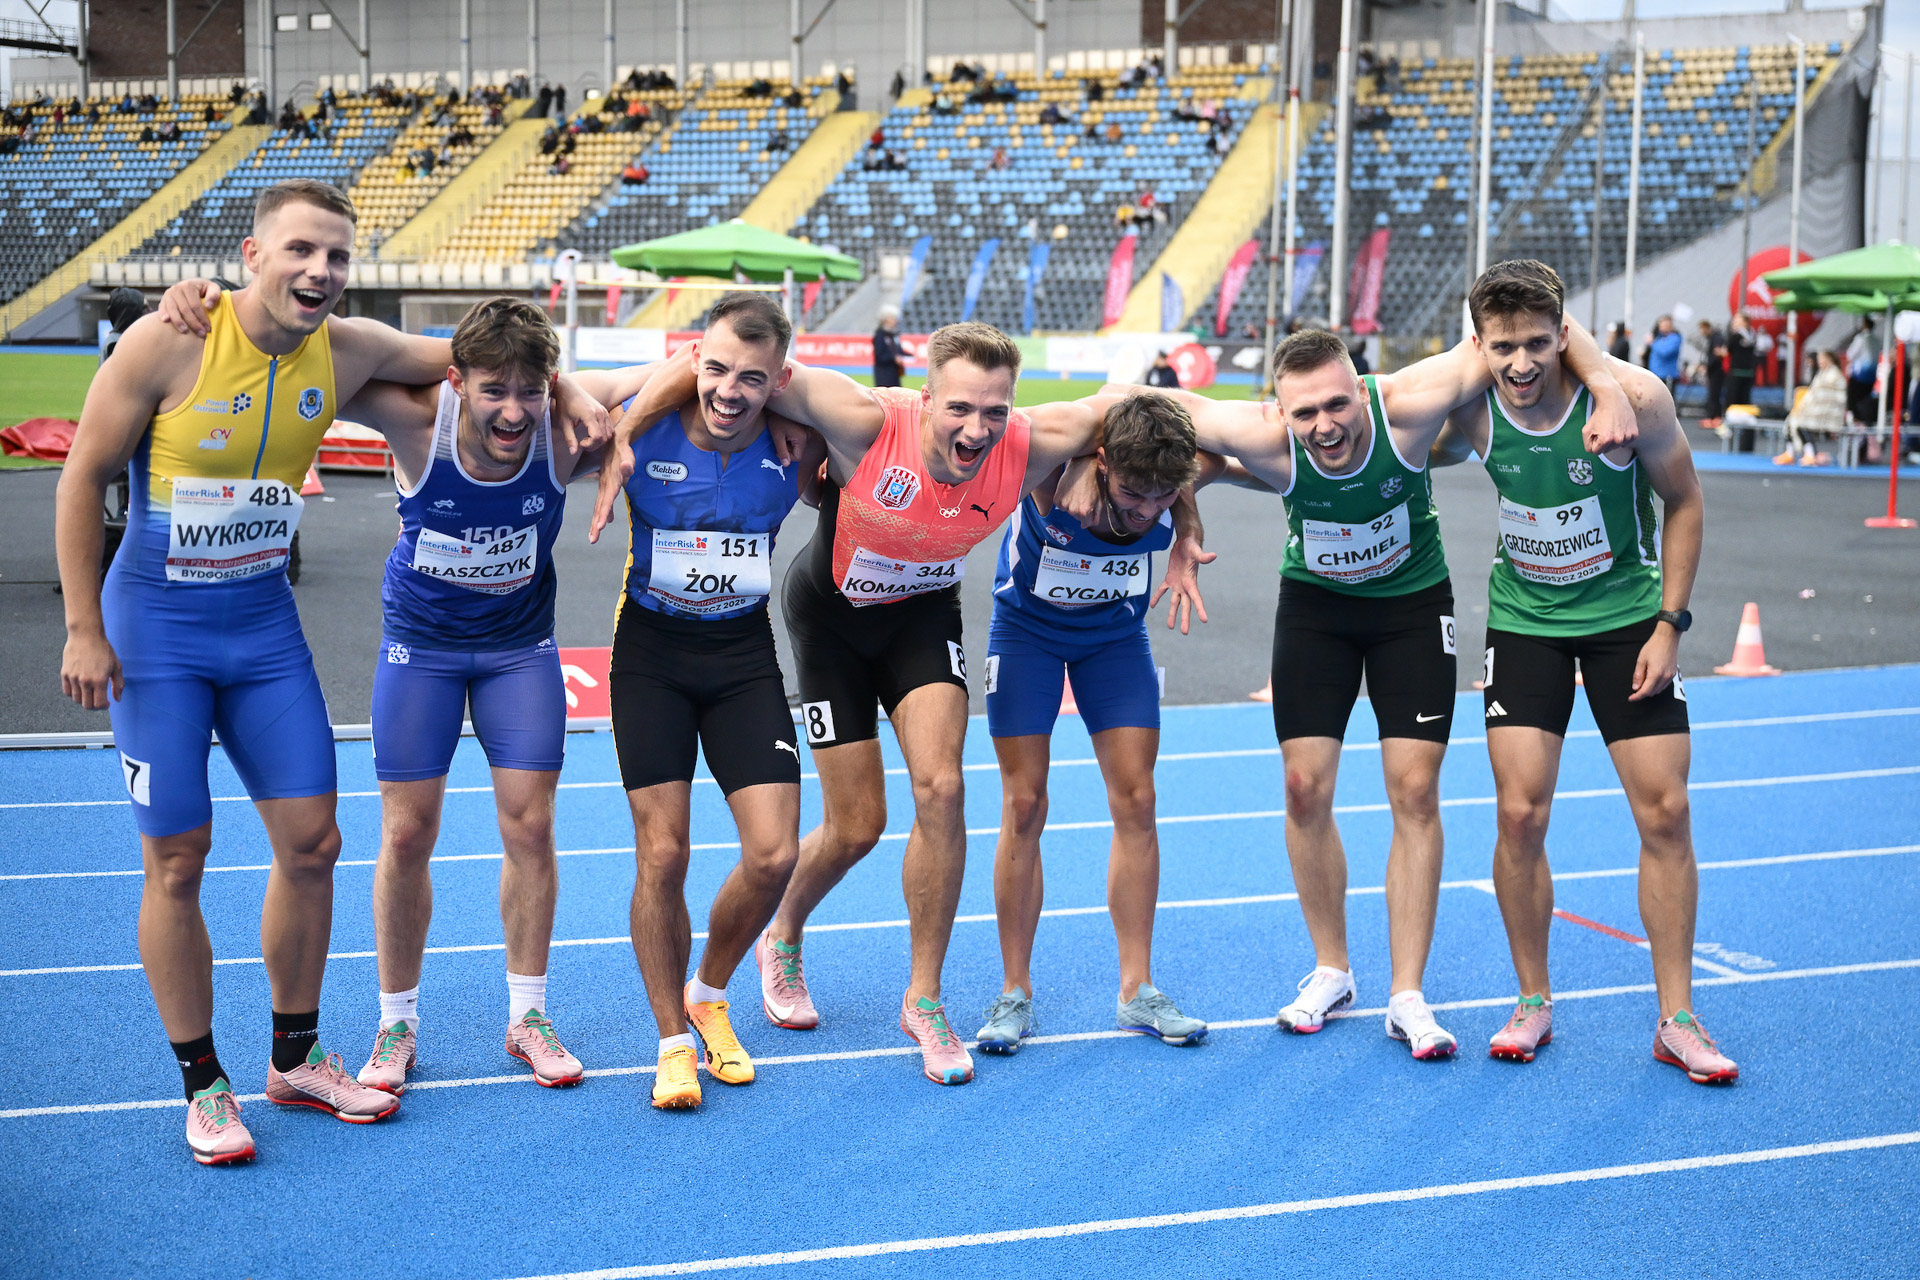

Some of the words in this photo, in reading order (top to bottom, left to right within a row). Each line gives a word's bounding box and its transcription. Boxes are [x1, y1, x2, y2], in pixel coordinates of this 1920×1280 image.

[175, 487, 220, 498] InterRisk
[249, 486, 293, 506] 481
[1370, 514, 1394, 534] 92
[1556, 506, 1583, 526] 99
[177, 520, 288, 547] WYKROTA
[1306, 528, 1340, 537] InterRisk
[419, 538, 460, 553] InterRisk
[486, 533, 527, 556] 487
[656, 538, 695, 549] InterRisk
[721, 538, 758, 557] 151
[1317, 536, 1399, 566] CHMIEL
[1505, 527, 1603, 558] GRZEGORZEWICZ
[190, 559, 212, 568] PZLA
[214, 554, 258, 568] Mistrzostwa
[418, 555, 532, 578] BŁASZCZYK
[855, 554, 893, 569] InterRisk
[916, 563, 956, 577] 344
[1043, 556, 1079, 569] InterRisk
[1101, 560, 1140, 576] 436
[1383, 559, 1401, 574] 2025
[1540, 562, 1584, 574] Mistrzostwa
[1584, 553, 1606, 566] Polski
[181, 568, 248, 579] BYDGOSZCZ
[250, 562, 271, 573] 2025
[1522, 570, 1576, 582] BYDGOSZCZ
[1578, 566, 1600, 578] 2025
[683, 568, 737, 593] ŻOK
[1048, 586, 1129, 600] CYGAN
[660, 596, 721, 613] BYDGOSZCZ
[724, 598, 746, 609] 2025
[1446, 623, 1455, 647] 9
[808, 706, 827, 739] 8
[125, 758, 141, 794] 7
